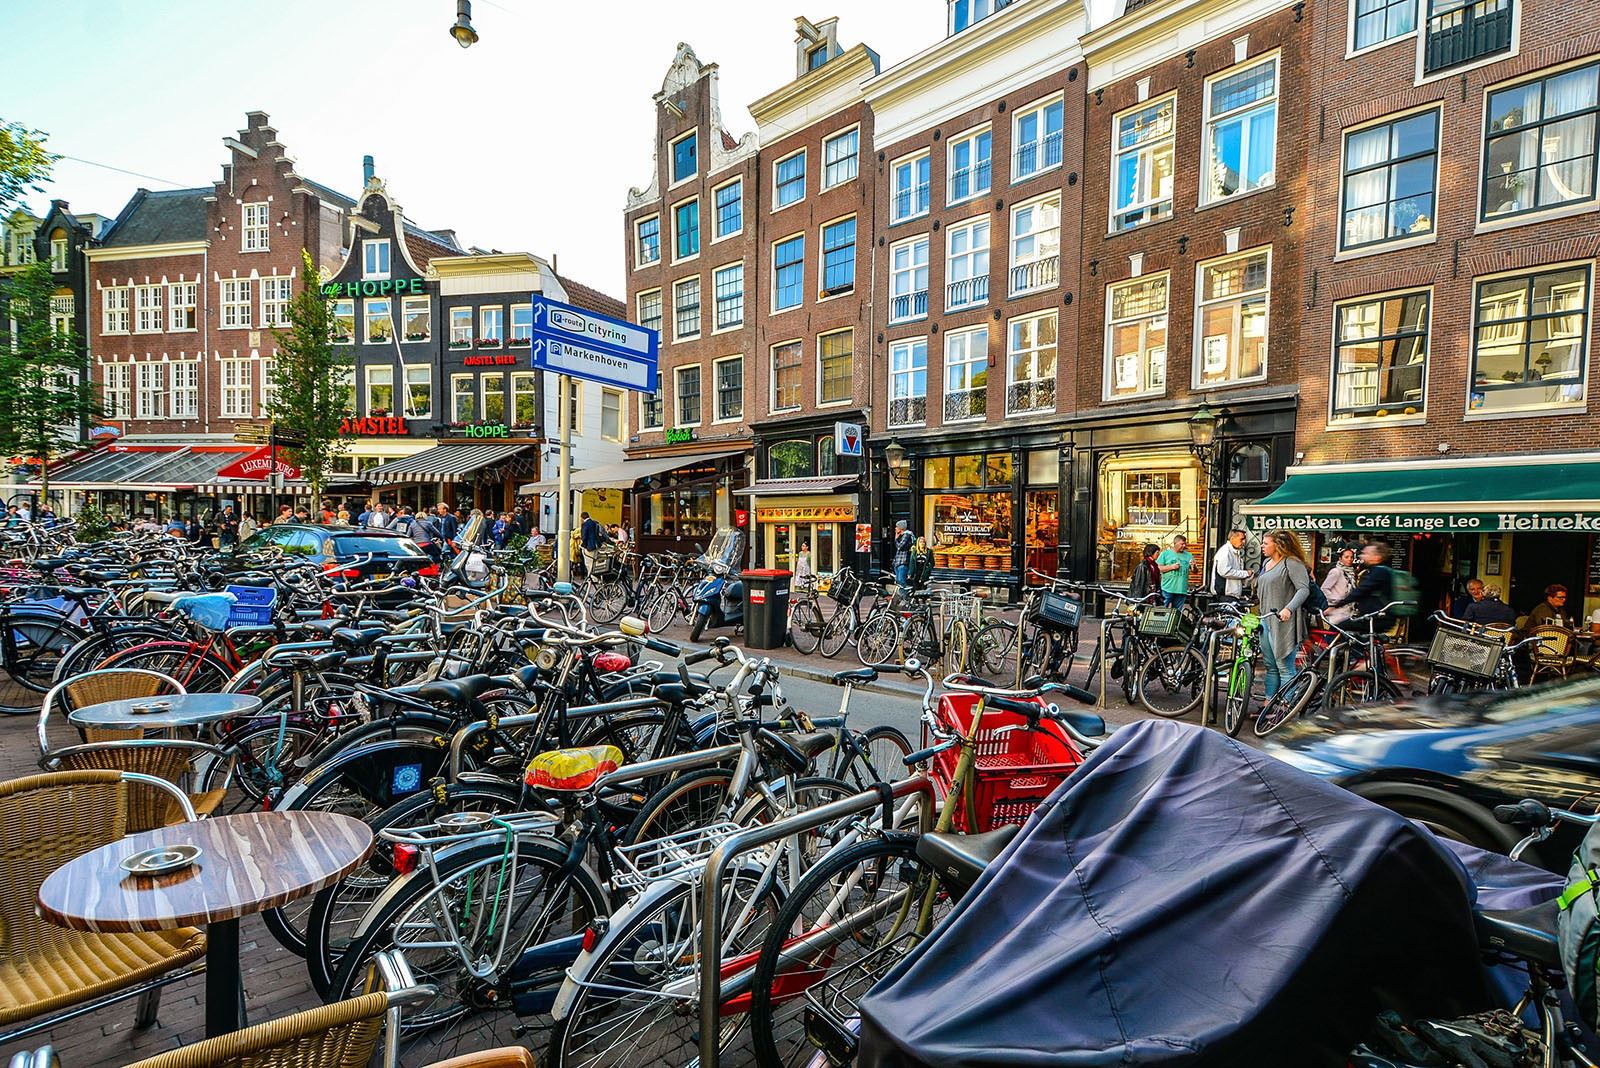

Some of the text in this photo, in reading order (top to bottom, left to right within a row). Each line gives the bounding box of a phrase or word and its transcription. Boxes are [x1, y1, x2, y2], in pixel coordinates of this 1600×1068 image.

[320, 278, 424, 298] Café HOPPE
[587, 322, 627, 343] Cityring
[463, 355, 516, 365] AMSTEL BIER
[564, 345, 628, 370] Markenhoven
[338, 416, 408, 435] AMSTEL
[465, 425, 509, 438] HOPPE
[1252, 515, 1343, 530] Heineken
[1355, 515, 1390, 528] Café
[1395, 516, 1444, 530] Lange
[1449, 515, 1480, 528] Leo
